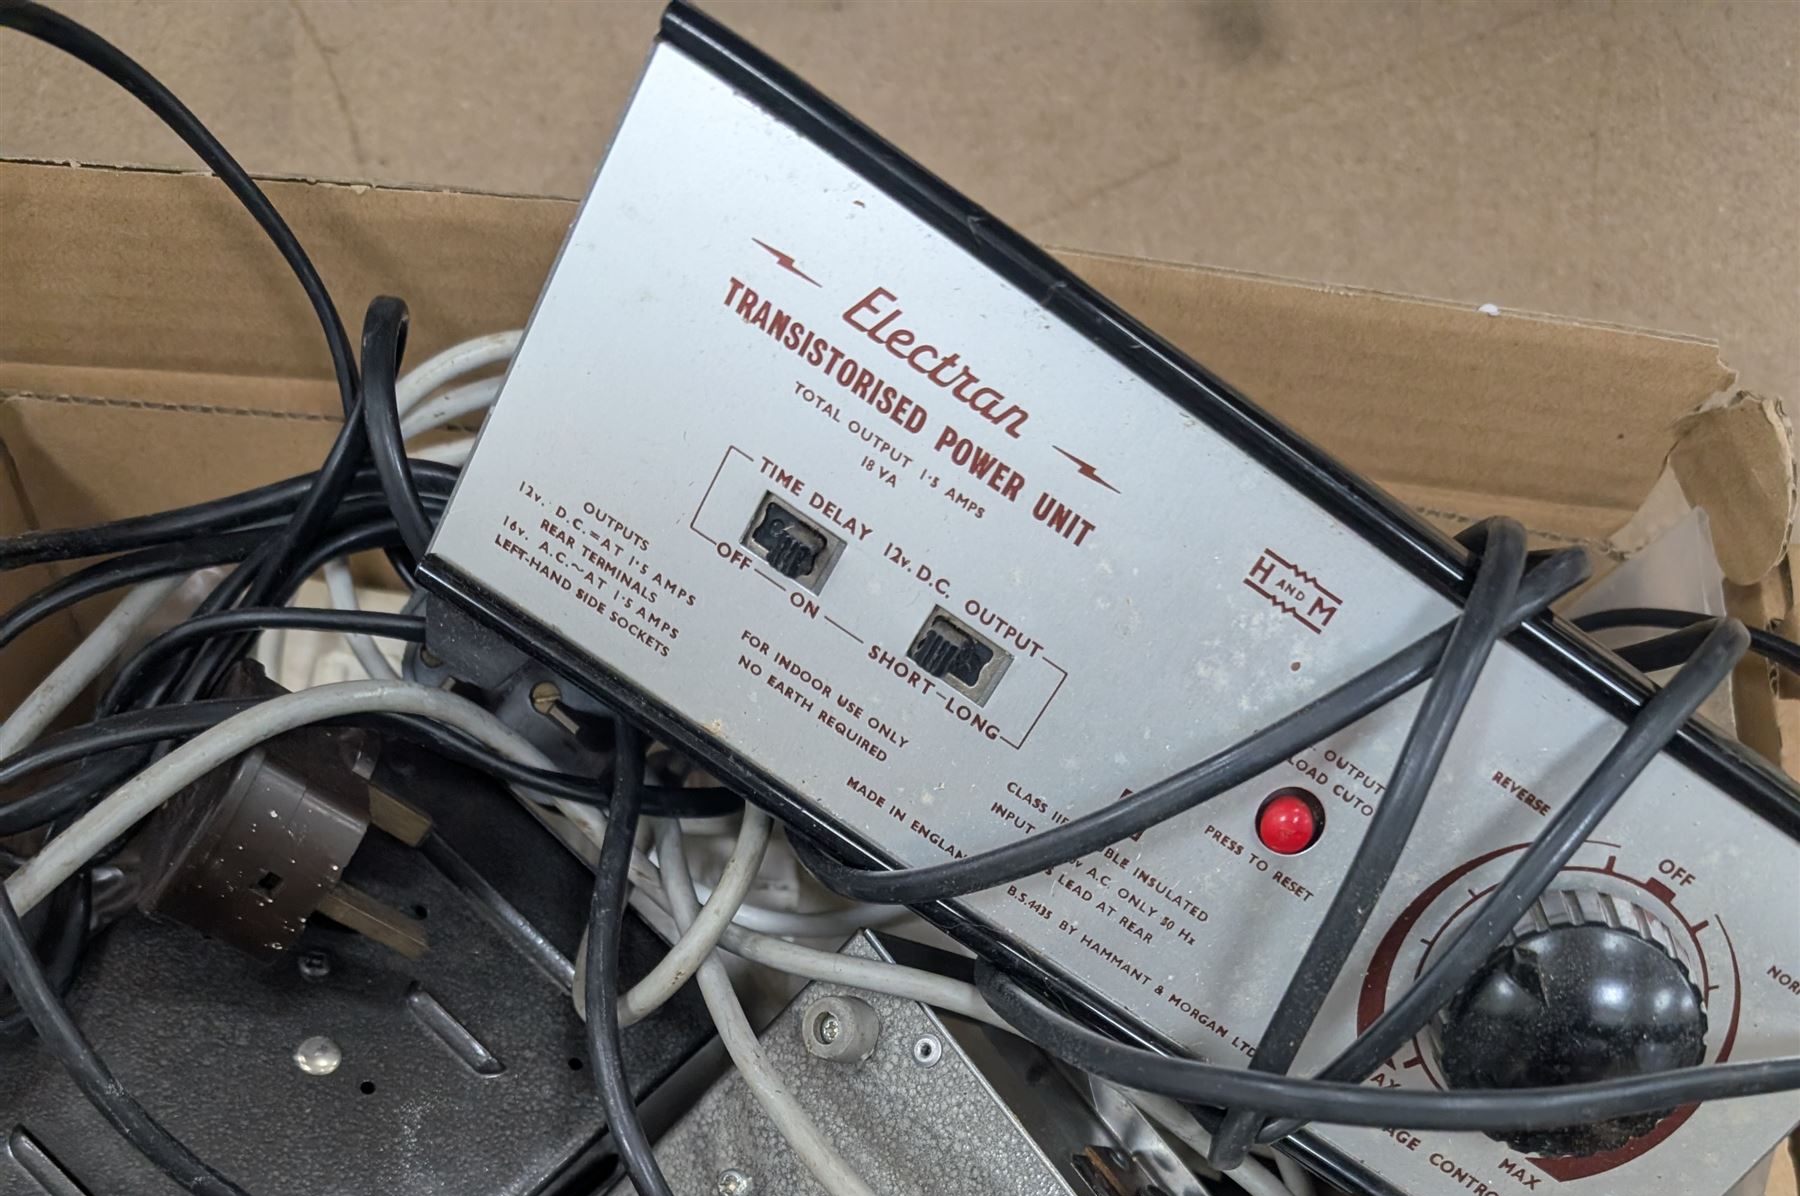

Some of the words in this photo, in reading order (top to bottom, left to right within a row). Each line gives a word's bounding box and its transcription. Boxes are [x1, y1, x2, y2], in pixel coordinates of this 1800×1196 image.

[842, 286, 1029, 439] Electran
[723, 276, 928, 434] TRANSISTORISED
[934, 424, 1025, 502] POWER
[1032, 491, 1096, 547] UNIT
[795, 381, 841, 422] TOTAL
[848, 420, 914, 468] OUTPUT
[944, 487, 986, 519] AMPS
[861, 456, 876, 472] 18
[879, 466, 898, 488] VA
[583, 502, 651, 552] OUTPUTS
[759, 456, 806, 497] TIME
[809, 492, 874, 542] DELAY
[503, 515, 529, 541] 16v.
[635, 606, 680, 640] AMPS
[519, 481, 545, 506] 12v.
[652, 572, 696, 606] AMPS
[540, 518, 576, 549] REAR
[581, 544, 658, 604] TERMINALS
[716, 542, 752, 571] OFF
[494, 534, 572, 591] LEFT-HAND
[575, 588, 607, 615] SIDE
[609, 611, 671, 658] SOCKETS
[790, 592, 820, 620] ON
[916, 564, 951, 599] D.C.
[964, 600, 1044, 658] OUTPUT
[1249, 556, 1276, 584] H
[1275, 579, 1306, 601] AND
[1307, 596, 1337, 627] M
[741, 629, 770, 655] FOR
[774, 652, 833, 698] INDOOR
[837, 694, 864, 720] USE
[868, 717, 910, 749] ONLY
[868, 645, 936, 695] SHORT
[738, 655, 762, 677] NO
[766, 674, 814, 713] EARTH
[818, 709, 888, 763] REQUIRED
[945, 697, 1001, 741] LONG
[846, 776, 887, 809] MADE
[889, 804, 906, 822] IN
[1324, 750, 1388, 795] OUTPUT
[1333, 784, 1374, 817] CUTO
[1492, 771, 1552, 817] REVERSE
[990, 802, 1036, 835] INPUT
[1117, 887, 1158, 918] ONLY
[1006, 781, 1049, 814] CLASS
[1133, 867, 1209, 923] INSULATED
[1204, 824, 1245, 856] PRESS
[1248, 853, 1268, 872] TO
[1272, 871, 1315, 902] RESET
[1658, 859, 1696, 887] OFF
[1057, 873, 1093, 902] LEAD
[1095, 901, 1117, 917] AT
[1119, 916, 1154, 945] REAR
[1058, 920, 1078, 936] BY
[1080, 934, 1153, 986] HAMMANT
[1154, 984, 1165, 996] &
[1168, 993, 1229, 1038] MORGAN
[1766, 965, 1800, 996] NOR
[1498, 1157, 1542, 1191] MAX
